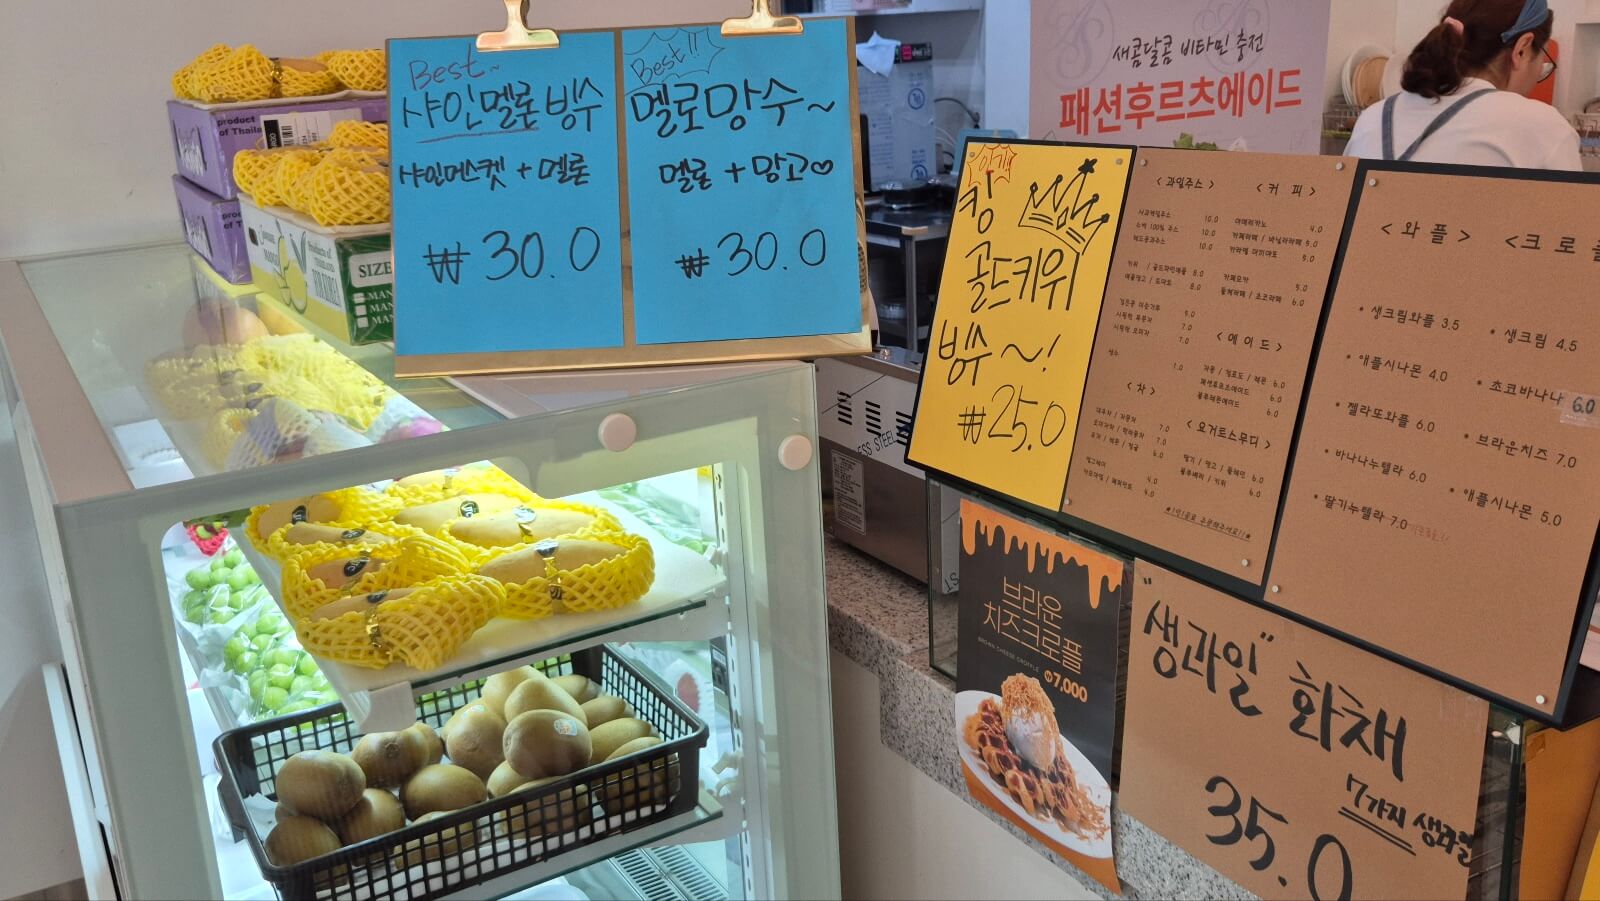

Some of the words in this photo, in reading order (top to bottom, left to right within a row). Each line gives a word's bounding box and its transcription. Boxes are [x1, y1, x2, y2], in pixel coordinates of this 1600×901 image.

[1112, 34, 1173, 68] 새콤달콤
[1180, 34, 1229, 57] 비타민
[1235, 28, 1264, 62] 충전
[1059, 68, 1302, 137] 패션후르츠에이드
[217, 116, 256, 126] product
[219, 128, 228, 137] of
[539, 153, 590, 186] 멜론
[959, 172, 994, 234] 킹
[1204, 215, 1219, 223] 10.0
[1309, 225, 1323, 233] 4.0
[1202, 229, 1216, 237] 10.0
[1305, 240, 1319, 248] 5.0
[1200, 242, 1213, 251] 10.0
[1302, 254, 1315, 263] 5.0
[359, 262, 392, 278] SIZE
[965, 241, 1080, 314] 골드키위
[1292, 298, 1305, 307] 6.0
[1371, 305, 1435, 329] 생크림와플
[1441, 318, 1460, 331] 3.5
[1504, 328, 1548, 349] 생크림
[1556, 338, 1578, 352] 4.5
[1359, 353, 1422, 379] 애플시나몬
[1428, 369, 1448, 382] 4.0
[1273, 379, 1286, 389] 6.0
[1269, 394, 1282, 403] 6.0
[1489, 380, 1564, 405] 초코바나나
[1572, 396, 1596, 414] 6.0
[1266, 408, 1279, 418] 6.0
[1347, 402, 1410, 429] 젤라또와플
[1416, 419, 1435, 433] 6.0
[874, 430, 898, 451] STEEL
[1476, 433, 1548, 461] 브라운치즈
[1556, 453, 1577, 469] 7.0
[1335, 449, 1404, 477] 바나나누텔라
[1409, 470, 1427, 483] 6.0
[1252, 474, 1264, 484] 6.0
[1249, 488, 1261, 498] 6.0
[1324, 494, 1385, 523] 딸기누텔라
[1390, 515, 1408, 530] 7.0
[1464, 488, 1533, 520] 애플시나몬
[1540, 511, 1562, 527] 5.0
[1001, 576, 1063, 630] 브라운
[983, 601, 1083, 674] 치즈크로플
[1289, 660, 1407, 783] 화채
[1346, 773, 1406, 829] 7가지
